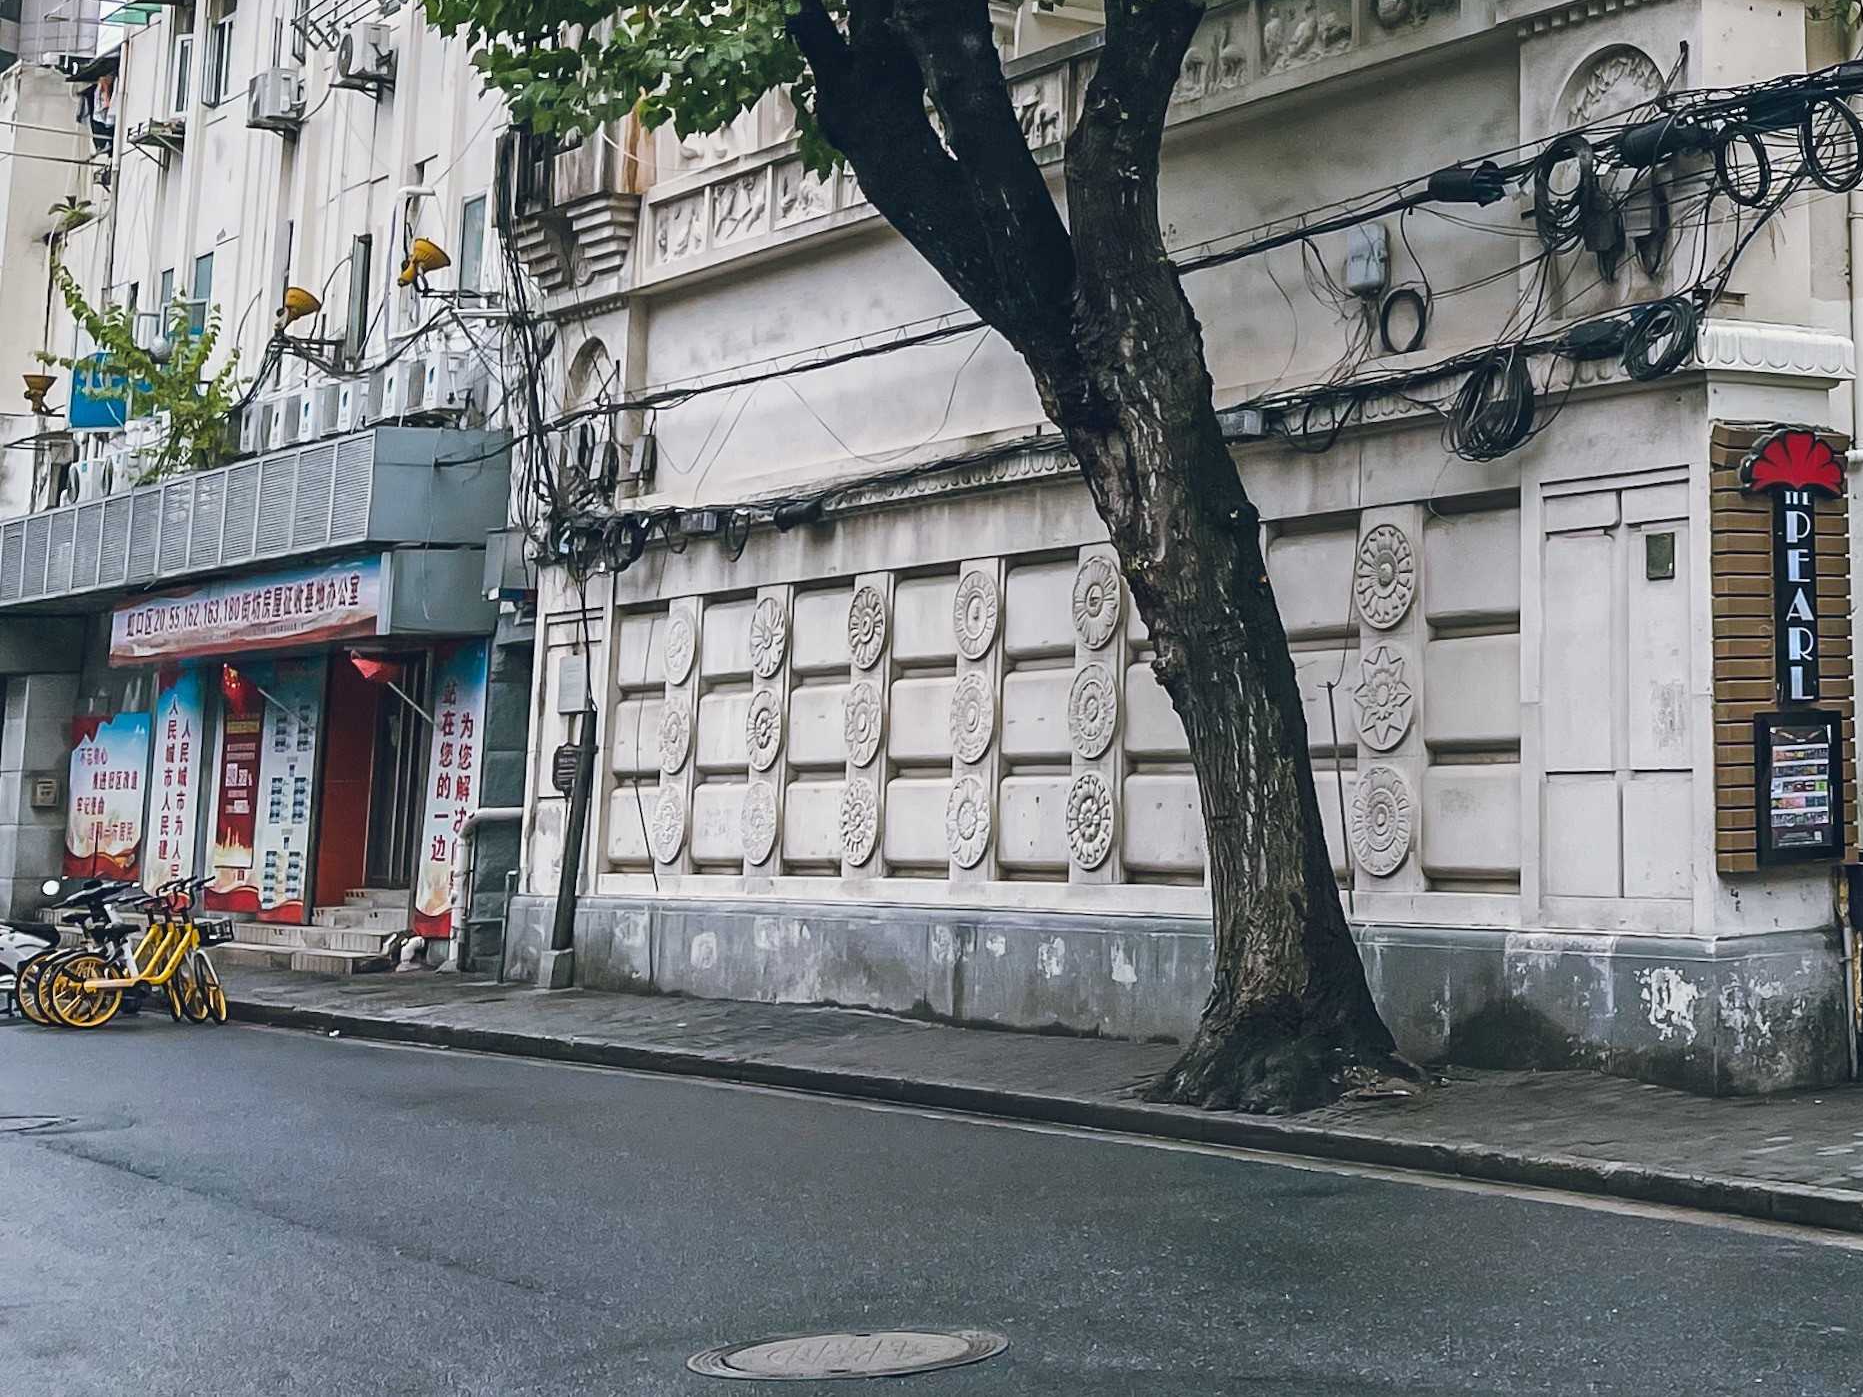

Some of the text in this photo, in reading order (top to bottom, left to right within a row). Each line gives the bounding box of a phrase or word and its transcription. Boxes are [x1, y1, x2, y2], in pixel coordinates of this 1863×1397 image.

[1785, 510, 1815, 700] PEARL
[158, 696, 179, 860] 人民城市人民建
